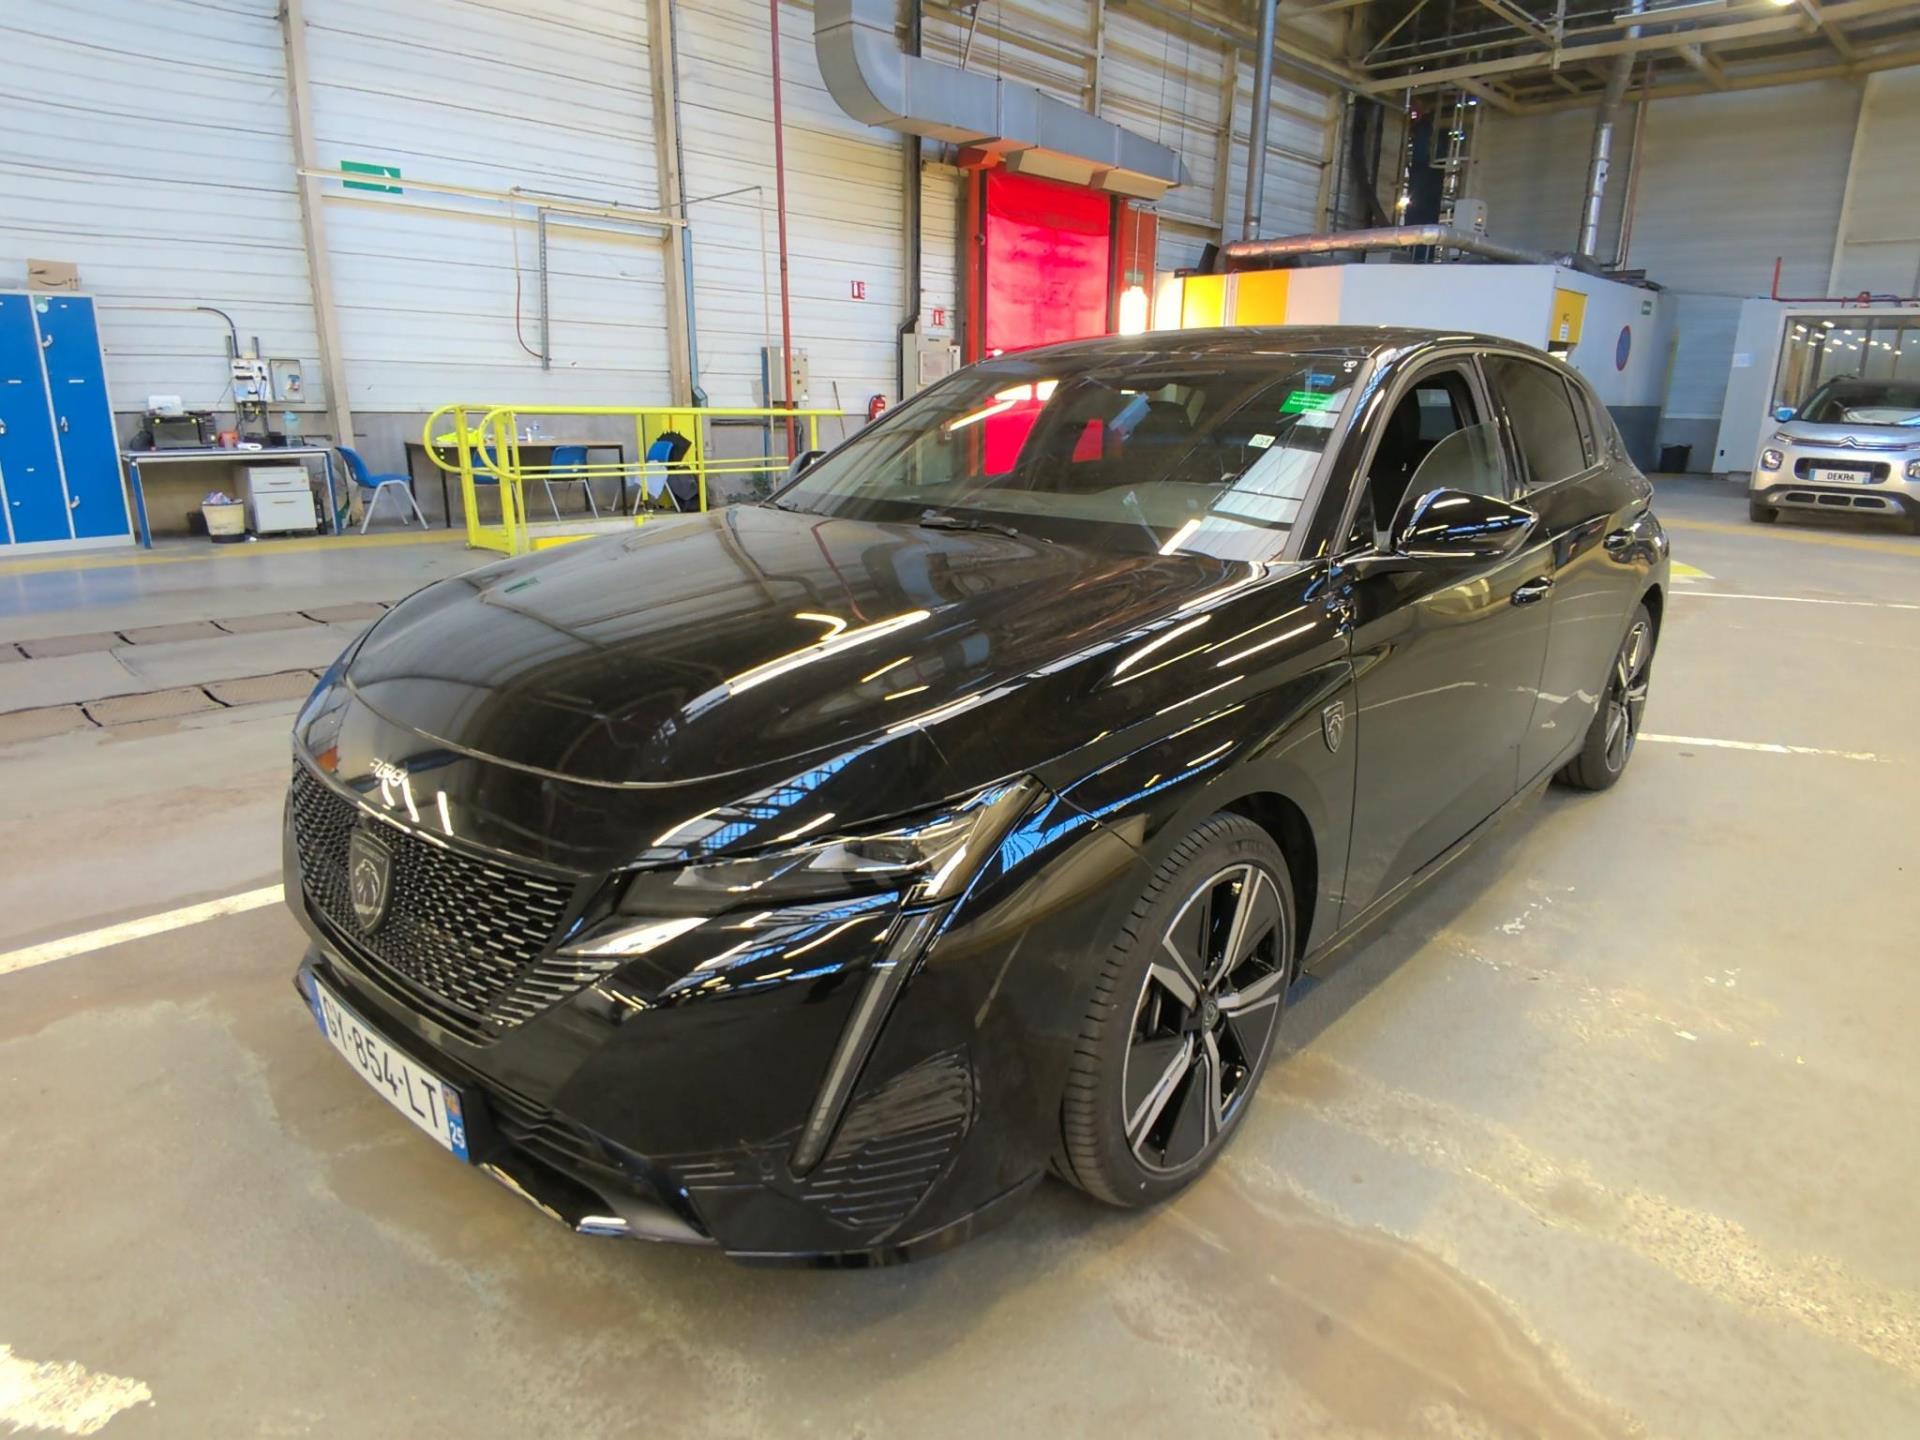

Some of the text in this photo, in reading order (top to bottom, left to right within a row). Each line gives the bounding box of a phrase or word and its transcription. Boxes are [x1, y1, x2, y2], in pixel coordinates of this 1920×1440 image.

[1827, 471, 1855, 481] DEKRA
[323, 996, 438, 1128] GY-854-LT
[450, 1121, 465, 1149] 25
